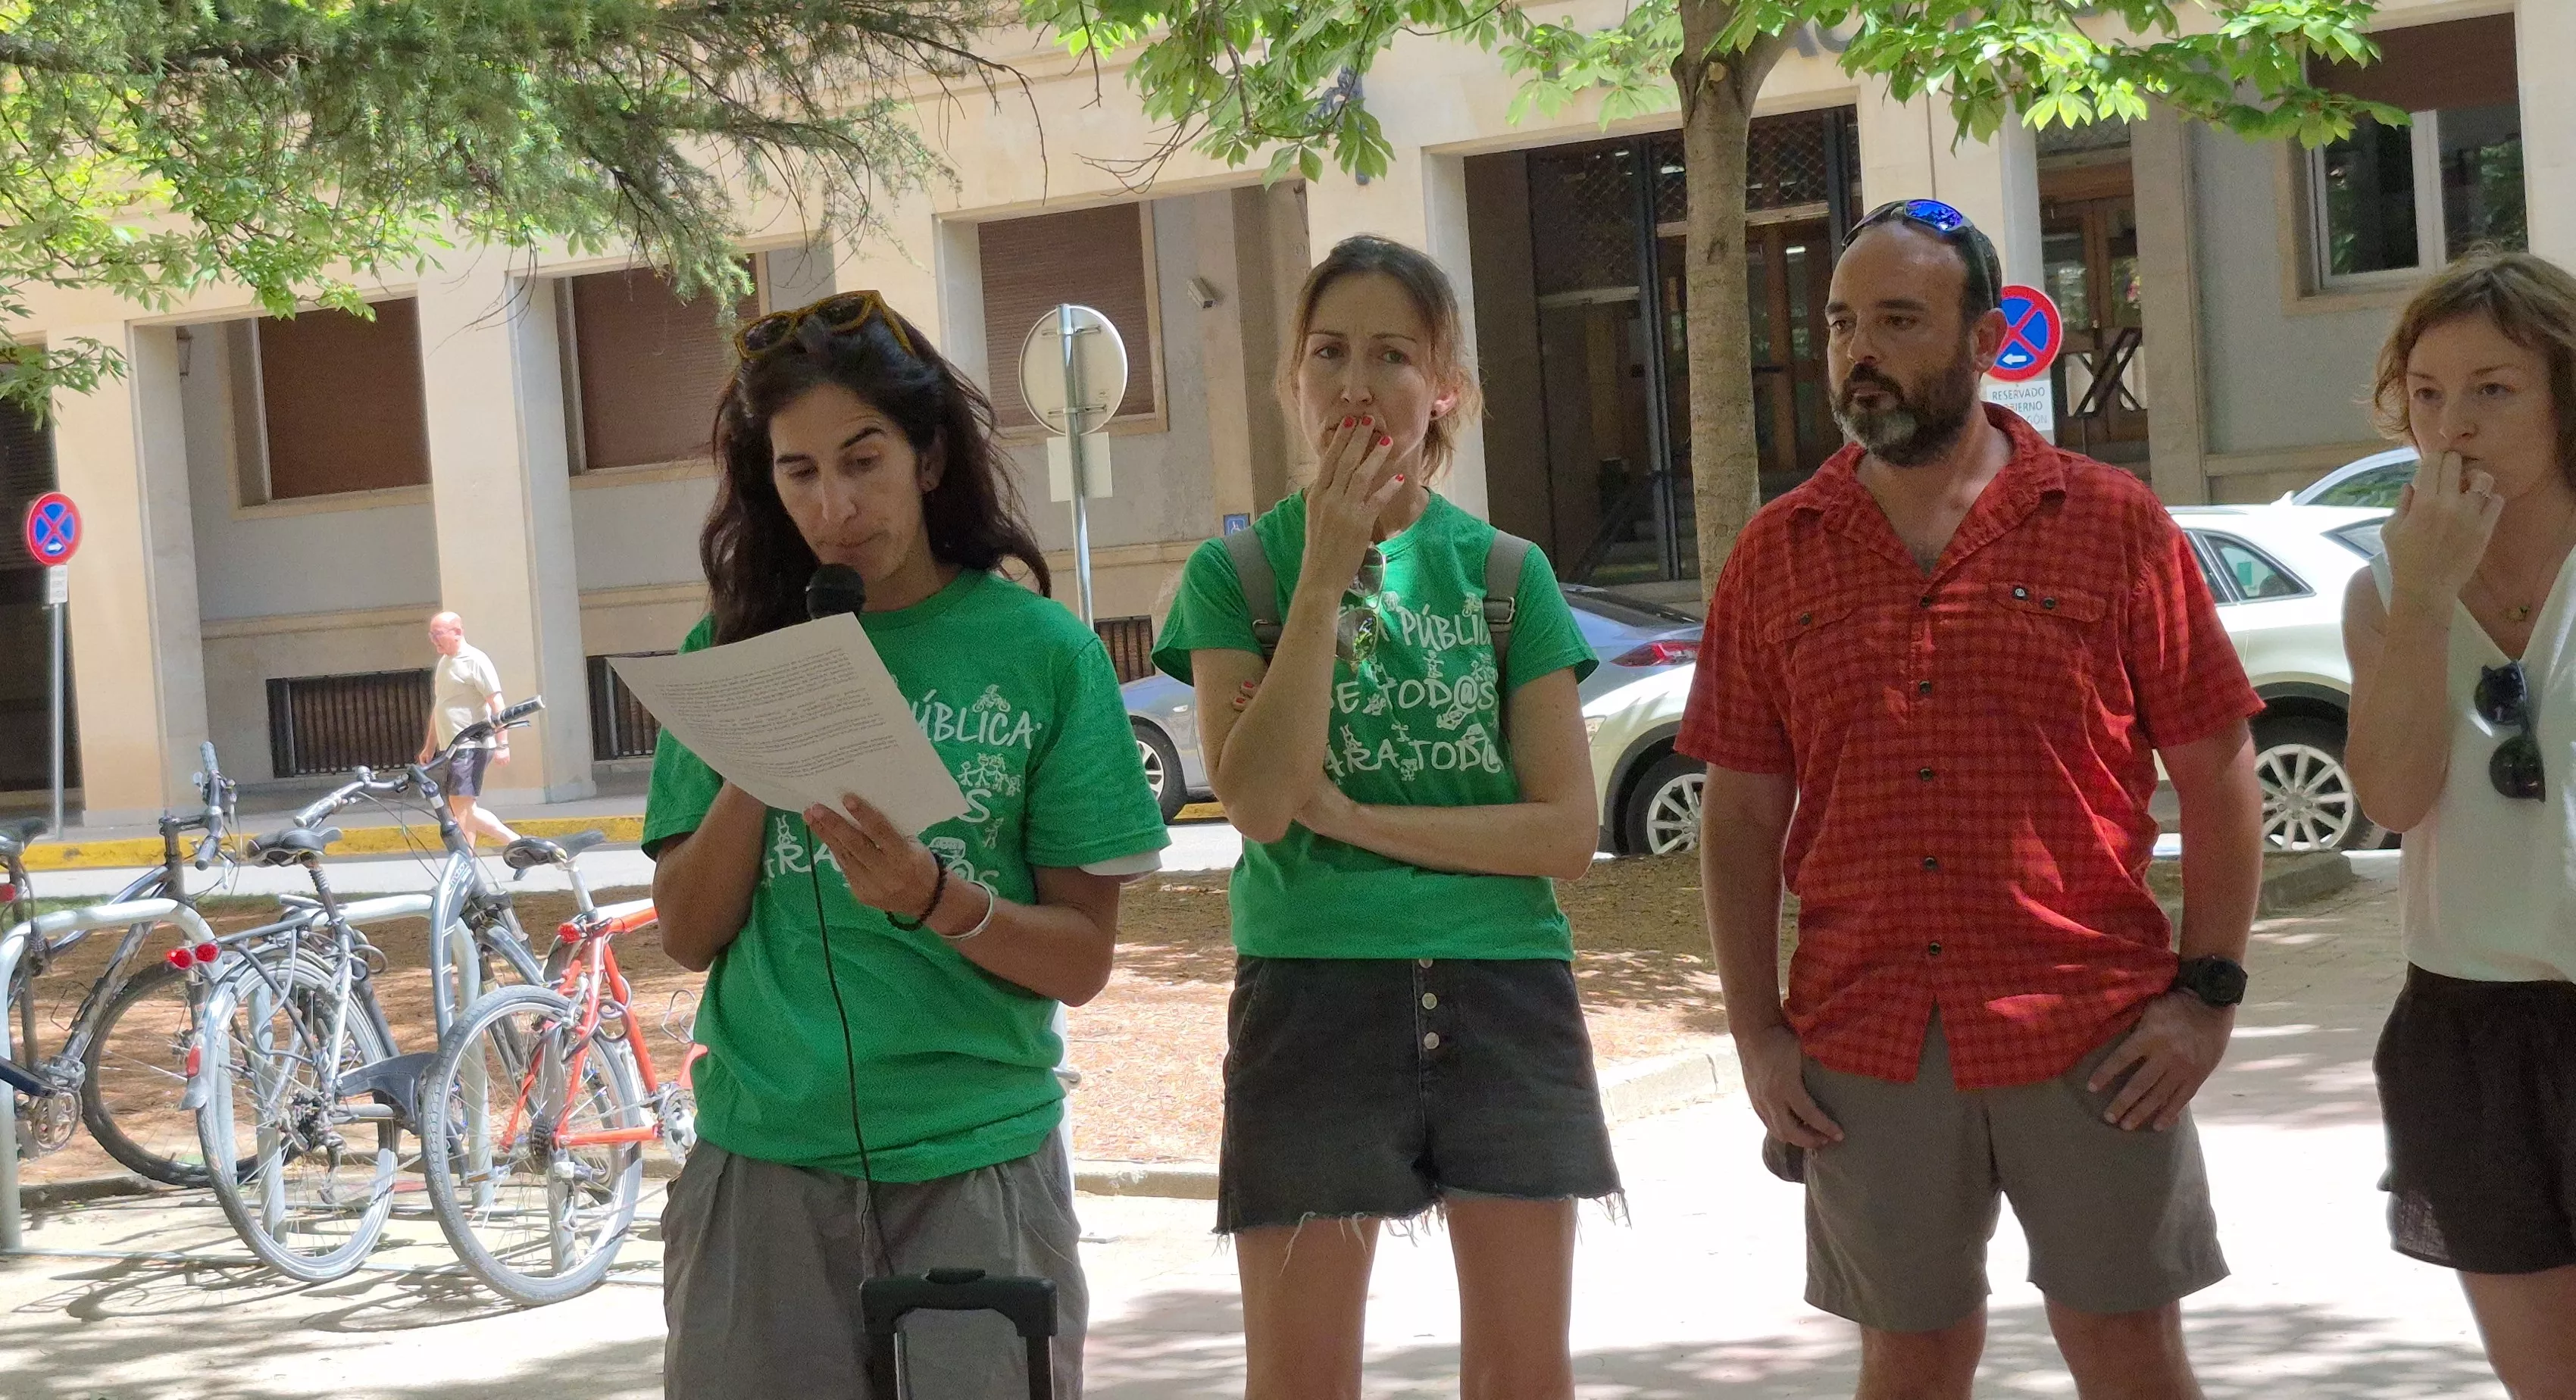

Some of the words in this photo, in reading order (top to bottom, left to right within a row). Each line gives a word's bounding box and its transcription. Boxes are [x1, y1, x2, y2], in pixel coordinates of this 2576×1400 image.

[1992, 386, 2045, 401] RESERVADO
[1377, 675, 1495, 713] TOD@S
[1326, 738, 1400, 777] ARA
